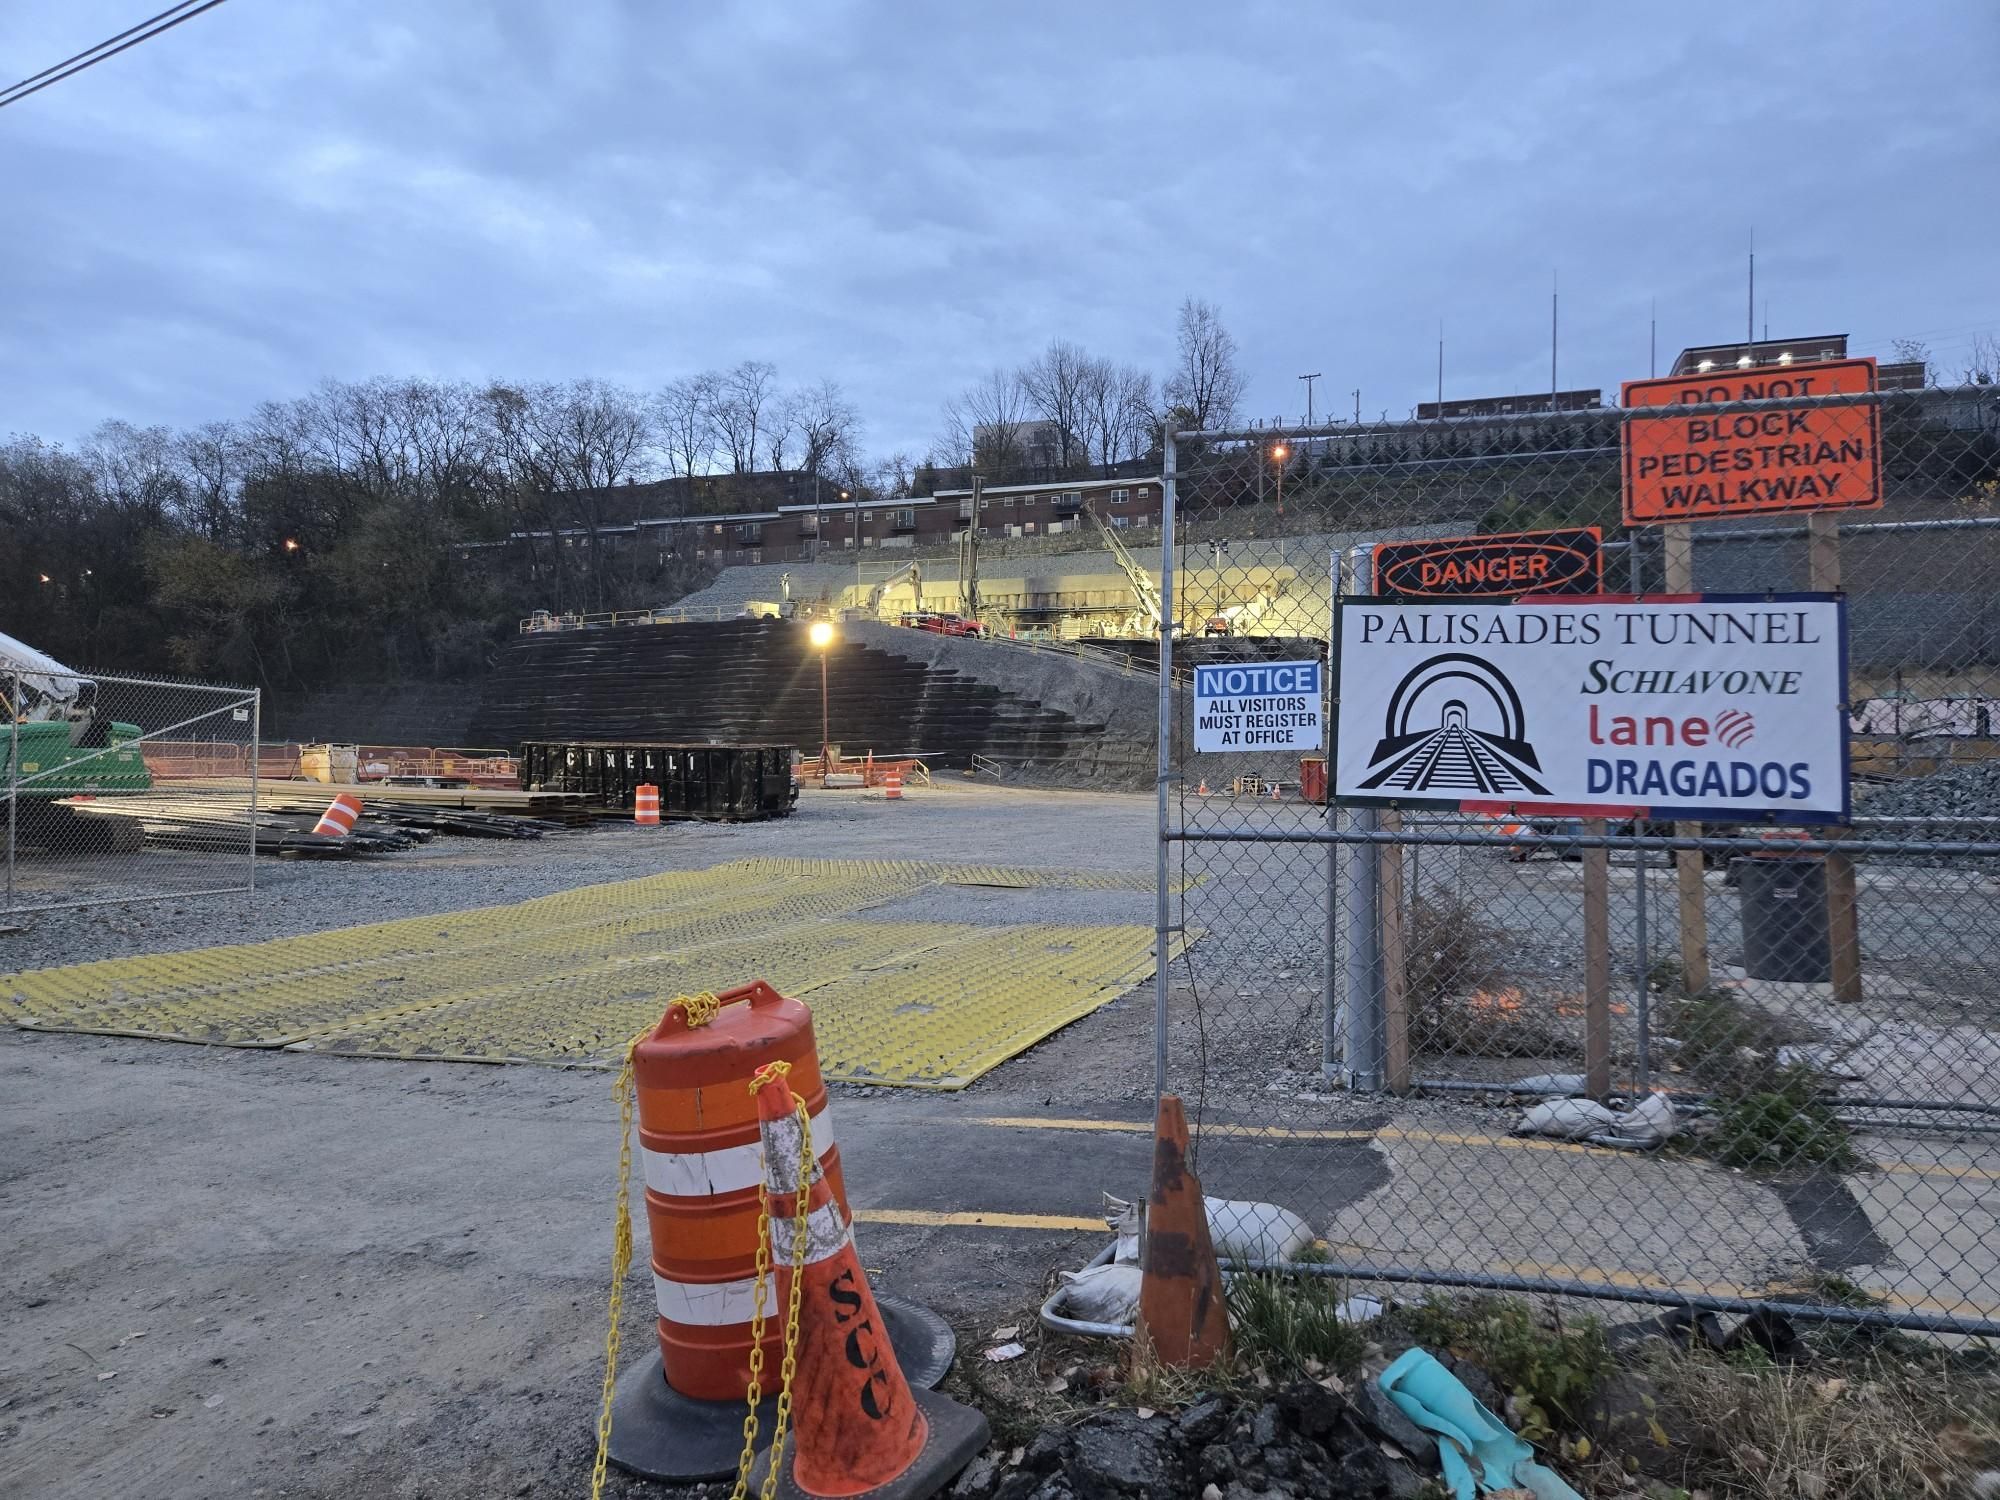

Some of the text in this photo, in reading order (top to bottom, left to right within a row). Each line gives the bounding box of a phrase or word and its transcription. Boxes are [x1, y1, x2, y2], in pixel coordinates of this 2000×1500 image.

[1741, 377, 1815, 401] NOT
[1688, 410, 1811, 443] BLOCK
[1639, 439, 1863, 479] PEDESTRIAN
[1662, 473, 1841, 508] WALKWAY
[1422, 554, 1549, 586] DANGER
[1360, 611, 1820, 644] PALISADES TUNNEL
[1203, 667, 1312, 694] NOTICE
[1200, 713, 1317, 729] MUST REGISTER
[1209, 697, 1306, 713] ALL VISITORS
[1222, 730, 1294, 744] AT OFFICE
[1589, 704, 1710, 746] lane
[566, 751, 694, 771] CINELLI
[1587, 759, 1811, 799] DRAGADOS
[829, 1269, 891, 1421] SCC
